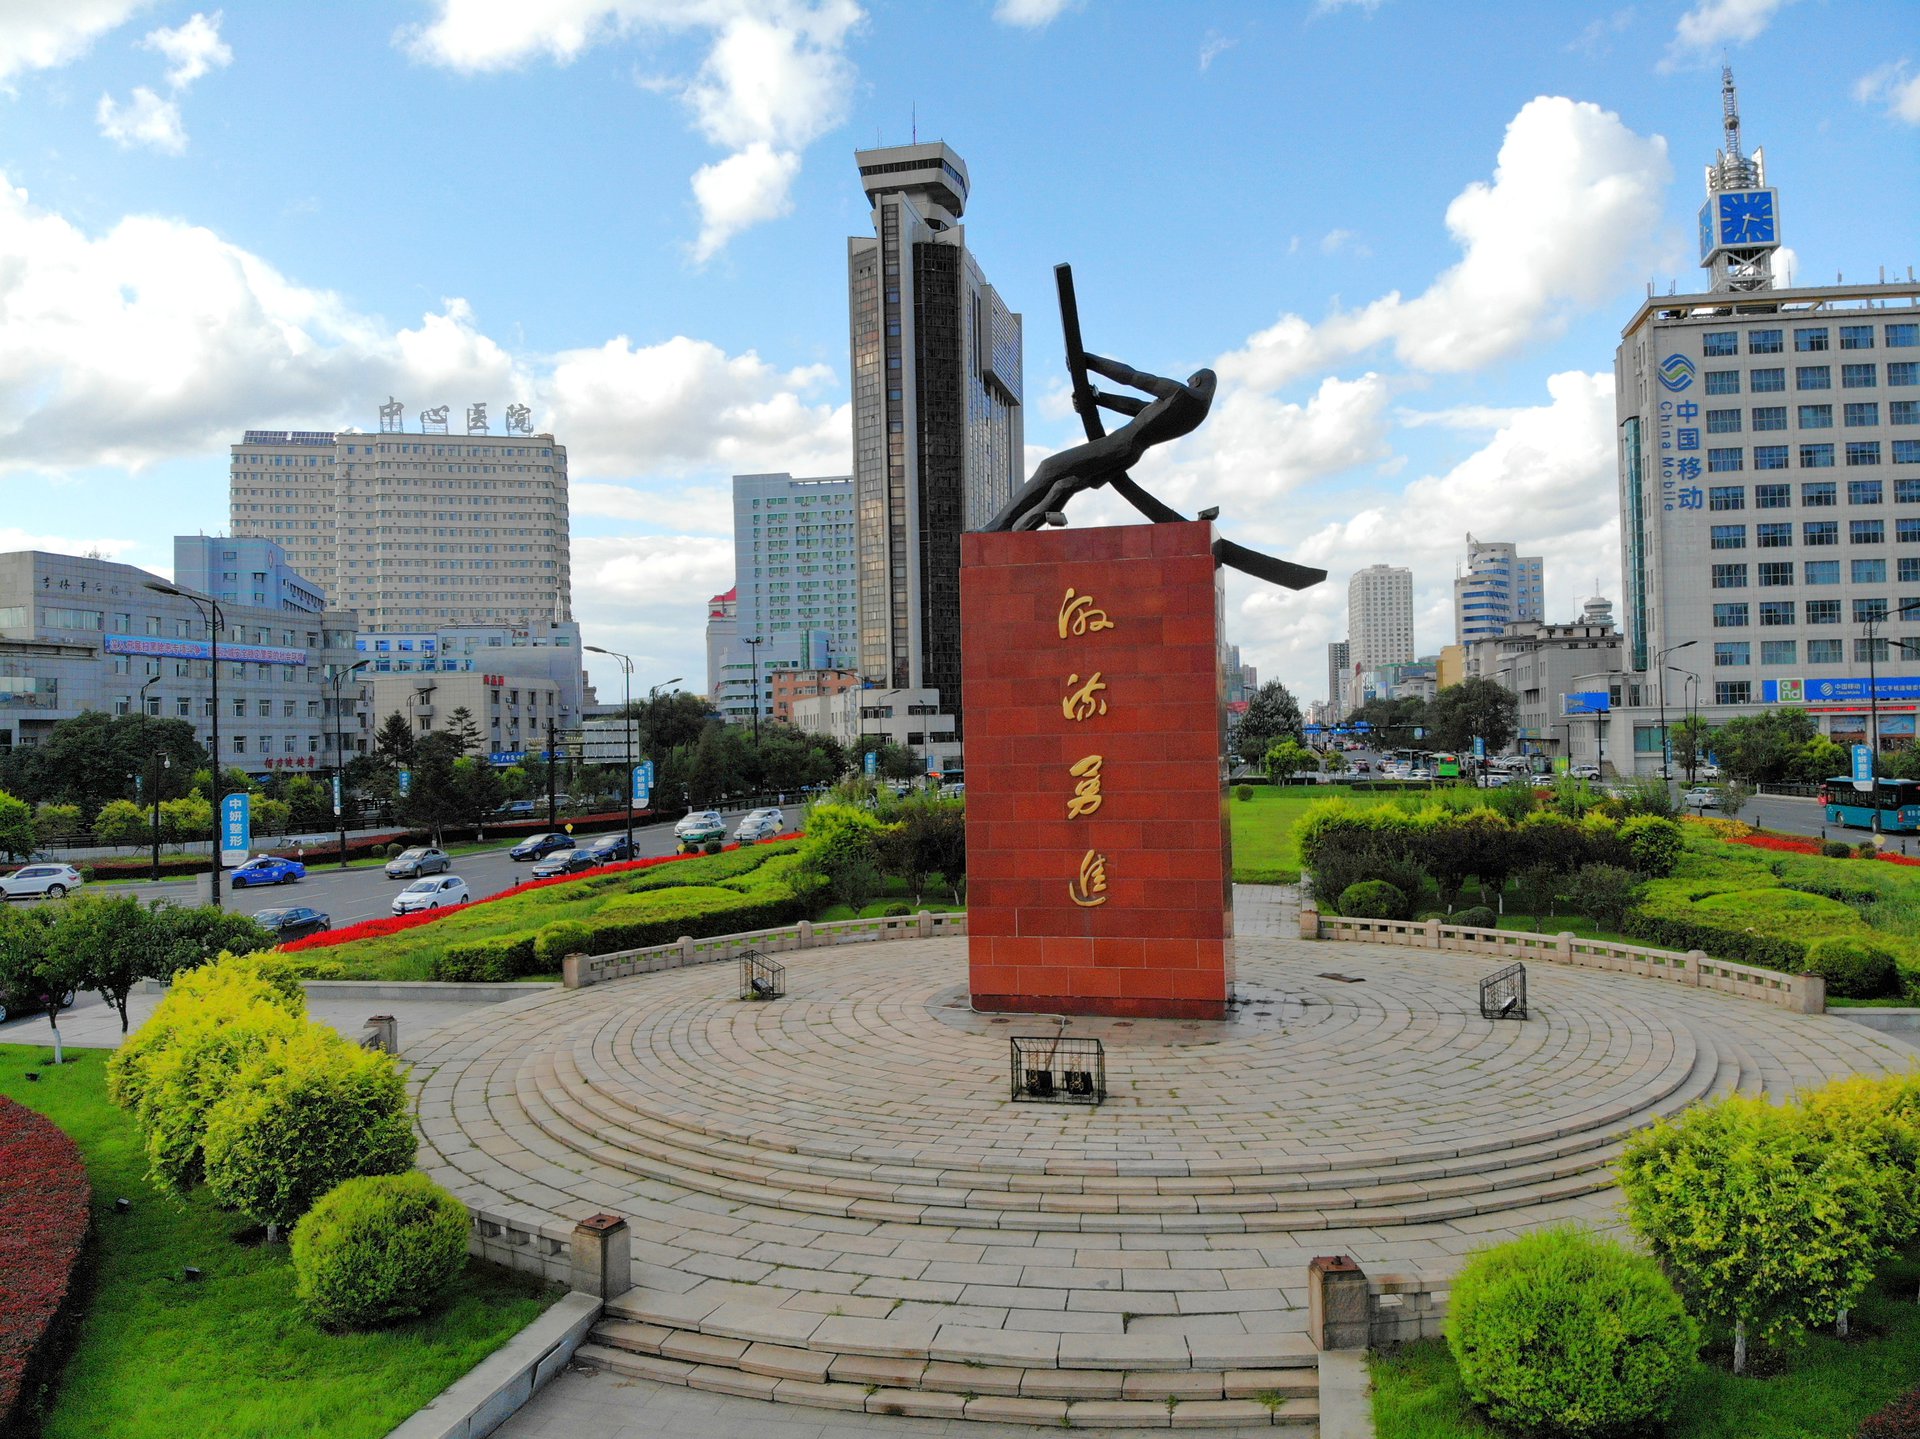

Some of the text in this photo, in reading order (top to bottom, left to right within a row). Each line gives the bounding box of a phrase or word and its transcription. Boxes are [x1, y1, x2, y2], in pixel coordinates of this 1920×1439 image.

[379, 395, 534, 433] 中心医院
[1660, 401, 1676, 511] China Mobile
[1676, 400, 1703, 510] 中国移动
[229, 799, 243, 847] 中妍整形
